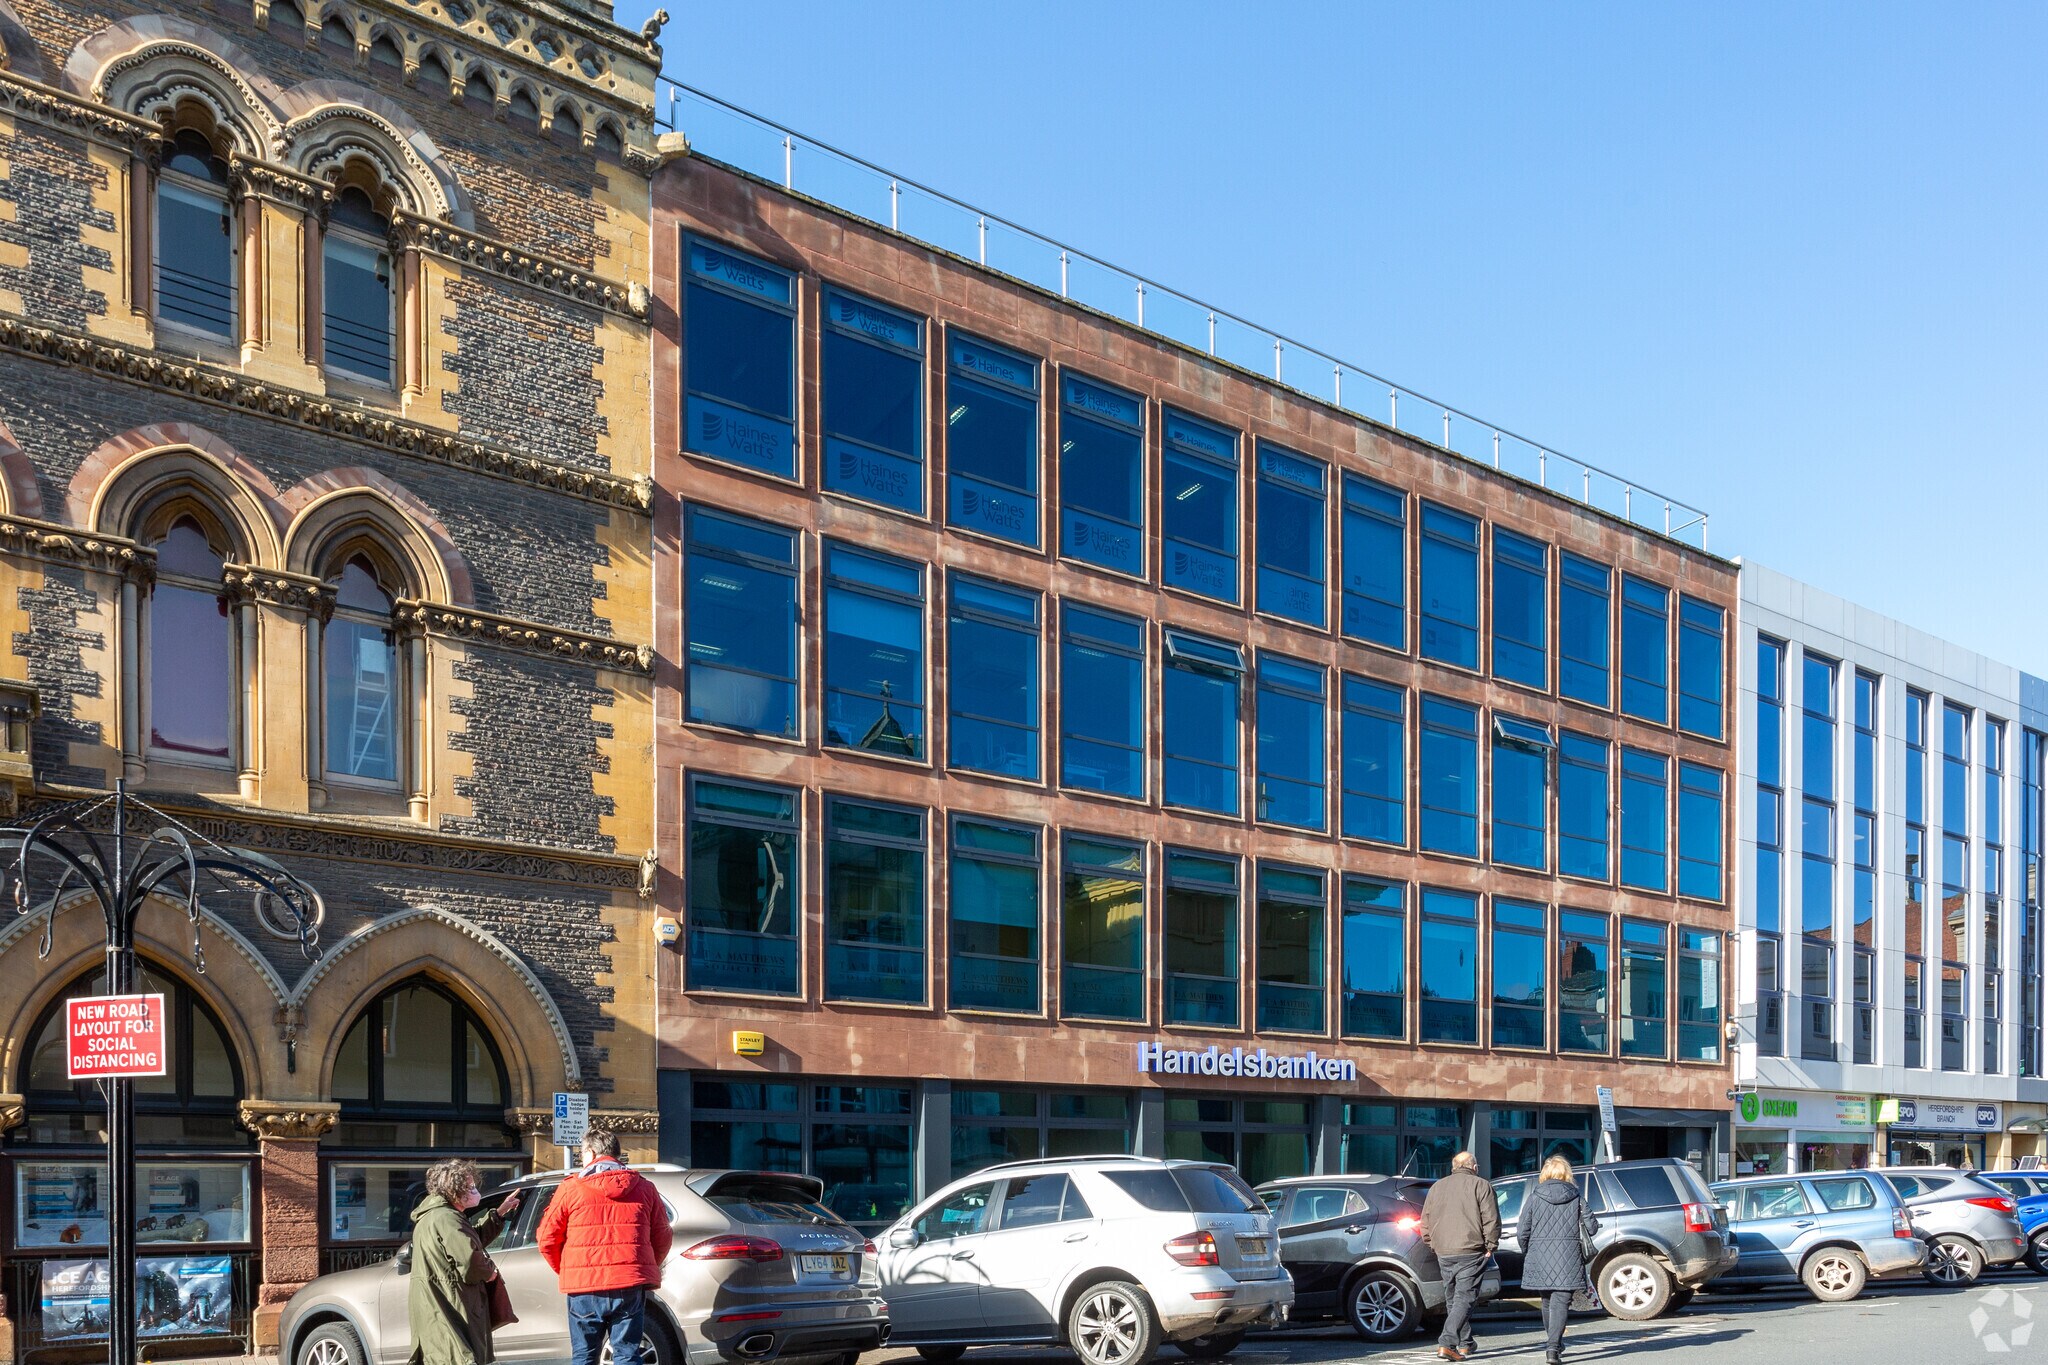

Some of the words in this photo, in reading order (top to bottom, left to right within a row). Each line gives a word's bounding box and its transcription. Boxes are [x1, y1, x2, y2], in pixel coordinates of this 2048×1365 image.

[725, 267, 765, 291] Watts
[858, 318, 895, 340] Watts
[978, 358, 1016, 381] Haines
[1088, 393, 1121, 413] Haines
[726, 418, 779, 447] Haines
[726, 433, 774, 460] Watts
[1186, 435, 1217, 454] Haines
[860, 458, 909, 485] Haines
[861, 472, 905, 497] Watts
[981, 493, 1025, 519] Haines
[982, 508, 1022, 531] Watts
[1091, 526, 1131, 549] Haines
[1092, 539, 1128, 561] Watts
[727, 952, 785, 965] MATTHEWS
[77, 1005, 105, 1020] NEW
[109, 1003, 149, 1018] ROAD
[74, 1020, 121, 1037] LAYOUT
[125, 1019, 154, 1034] FOR
[88, 1036, 137, 1052] SOCIAL
[73, 1052, 157, 1069] DISTANCING
[1138, 1041, 1357, 1081] Handelsbanken
[1762, 1099, 1798, 1118] OXFAM
[1898, 1106, 1914, 1118] SPCA
[1927, 1104, 1965, 1113] HEREFORDSHIRE
[1977, 1110, 1994, 1121] RSPCA
[1936, 1115, 1956, 1123] BRANCH
[805, 1256, 828, 1269] LY64
[831, 1256, 846, 1269] AAZ
[52, 1271, 80, 1284] ICE
[84, 1271, 110, 1284] AG
